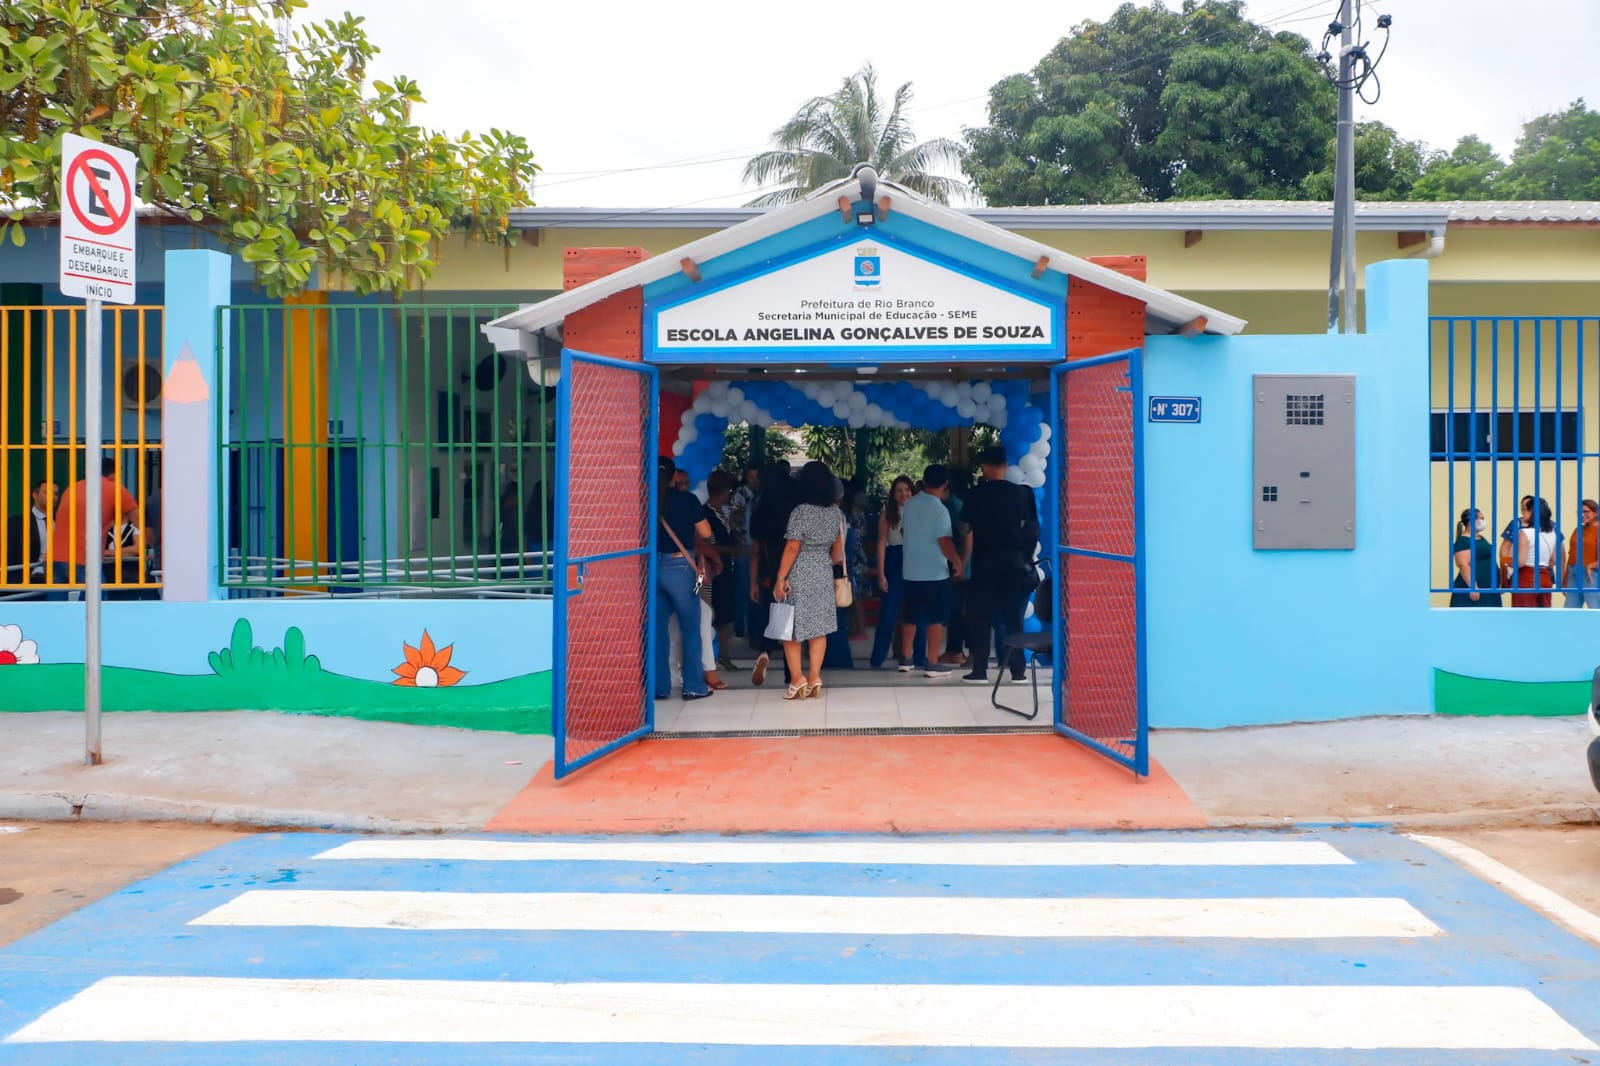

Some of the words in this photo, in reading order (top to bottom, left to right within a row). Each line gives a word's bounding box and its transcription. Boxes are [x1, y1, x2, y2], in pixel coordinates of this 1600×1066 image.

[73, 244, 118, 261] EMBARQUE
[119, 252, 125, 263] E
[68, 259, 129, 279] DESEMBARQUE
[86, 283, 113, 298] INÍCIO
[801, 300, 854, 309] Prefeitura
[857, 300, 871, 309] de
[875, 299, 893, 309] Rio
[896, 299, 935, 309] Branco
[758, 312, 812, 321] Secretaria
[815, 311, 866, 322] Municipal
[869, 311, 882, 320] de
[886, 310, 937, 321] Educação
[947, 310, 978, 319] SEME
[667, 328, 738, 341] ESCOLA
[743, 328, 835, 341] ANGELINA
[840, 326, 949, 342] GONÇALVES
[953, 326, 978, 339] DE
[982, 325, 1045, 339] SOUZA
[1171, 403, 1194, 416] 307
